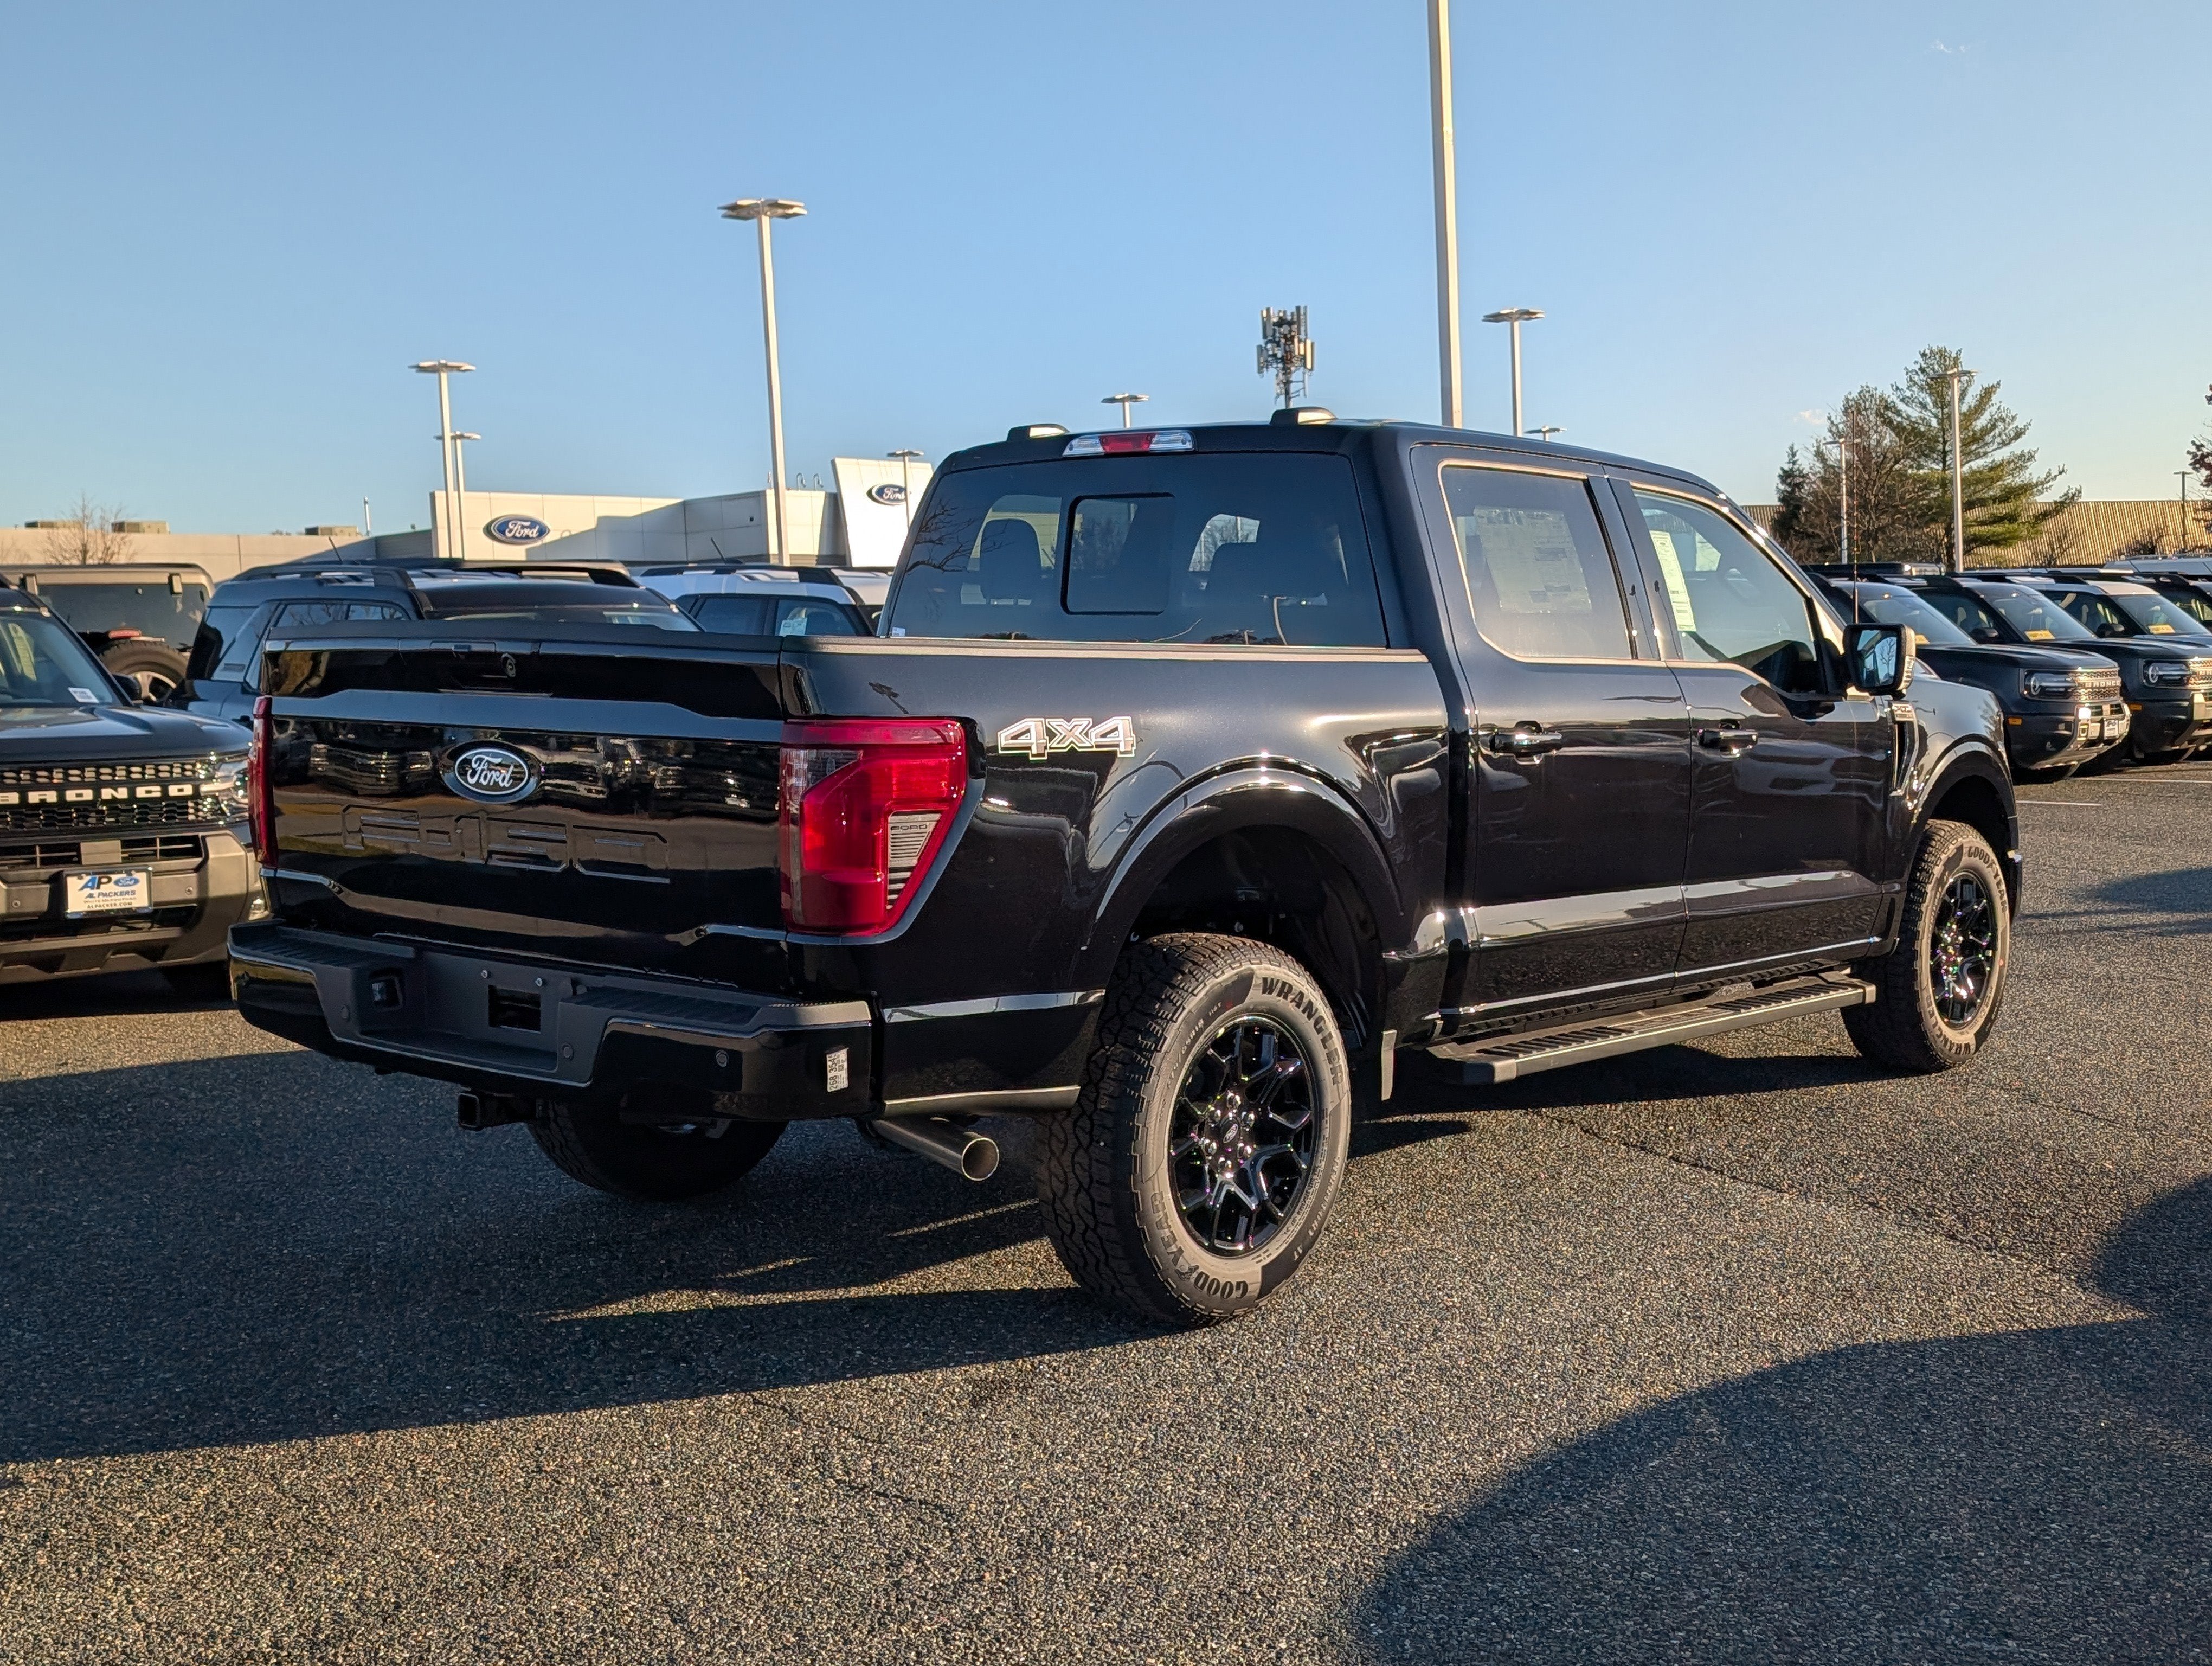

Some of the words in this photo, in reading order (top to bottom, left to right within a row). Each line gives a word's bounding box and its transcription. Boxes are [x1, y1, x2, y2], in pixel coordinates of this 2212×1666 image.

[505, 521, 539, 538] Ford
[467, 754, 515, 787] Ford
[1262, 977, 1343, 1086] WRANGLER
[829, 1075, 838, 1091] 268
[1151, 1191, 1249, 1299] GOODYEAR
